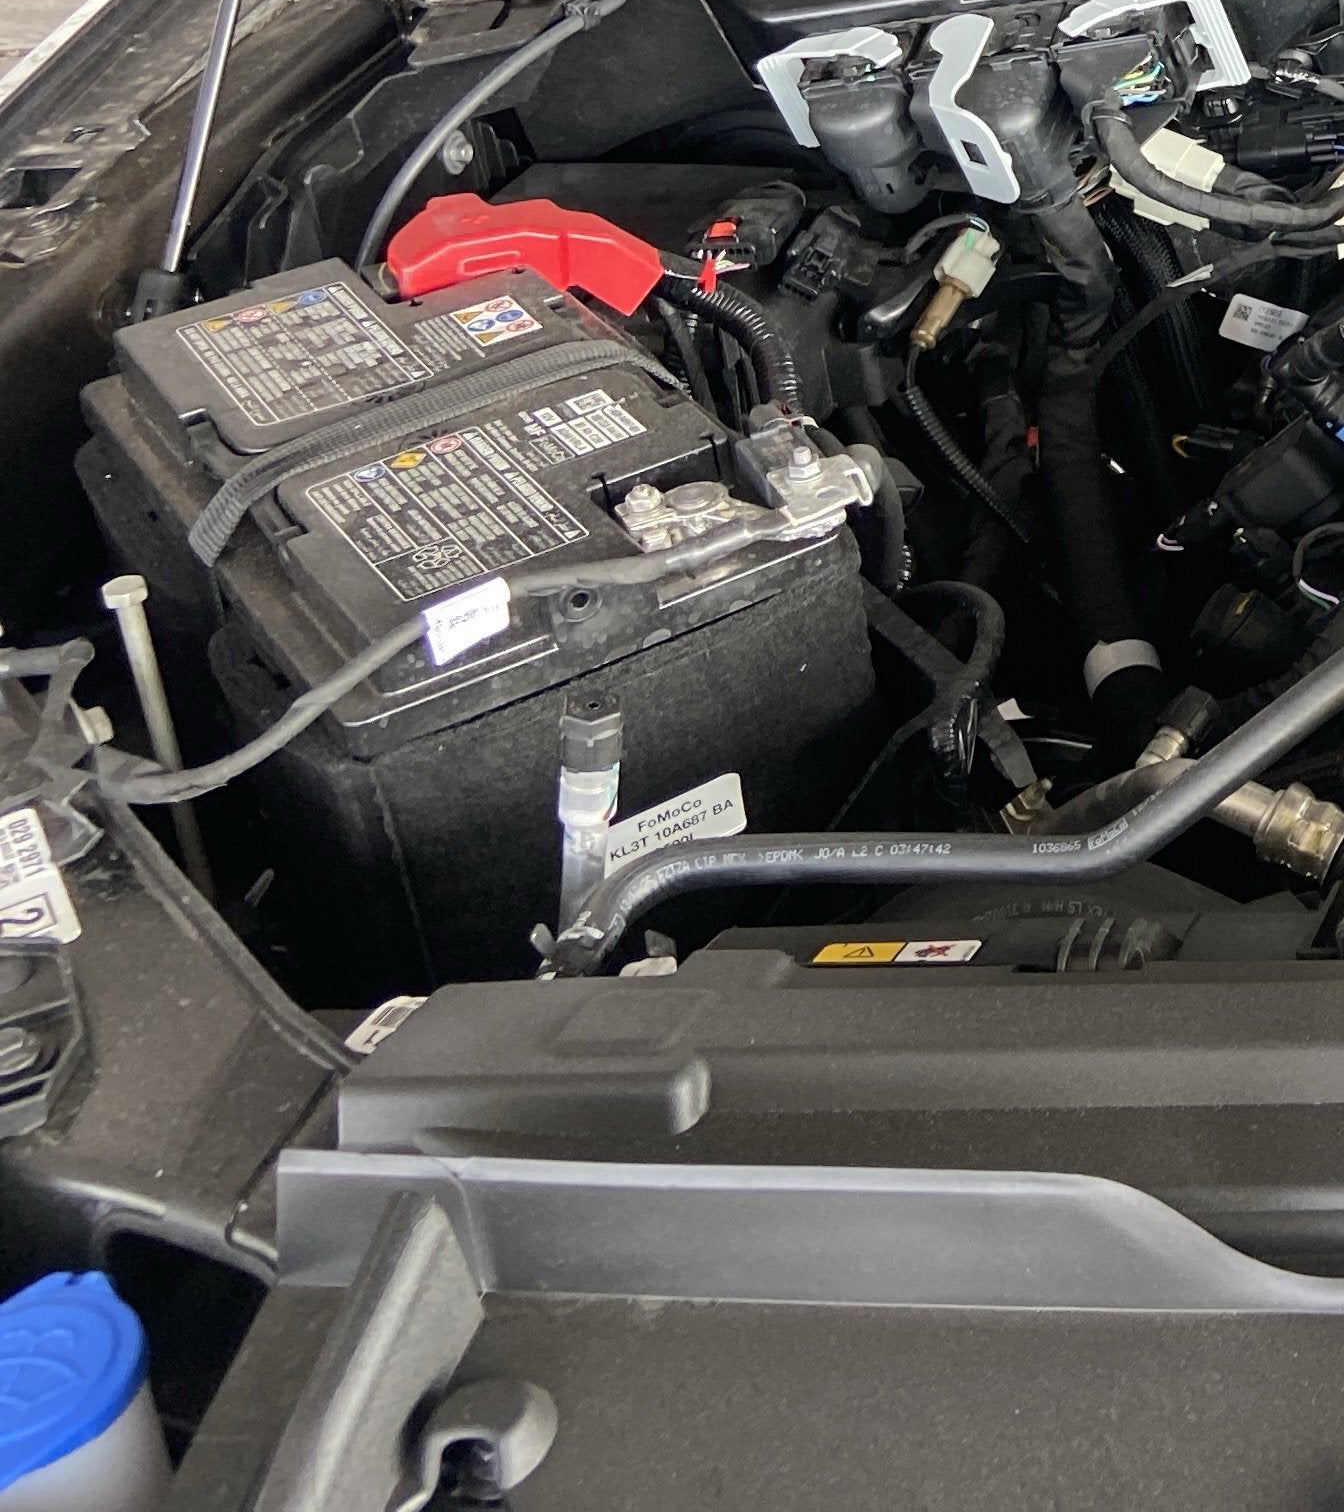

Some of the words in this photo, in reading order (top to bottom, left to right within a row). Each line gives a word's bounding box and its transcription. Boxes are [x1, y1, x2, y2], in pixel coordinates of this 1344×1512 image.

[609, 834, 651, 863] KL3T
[655, 809, 708, 842] 10A687
[712, 798, 735, 817] BA
[636, 798, 703, 833] FoMoCo
